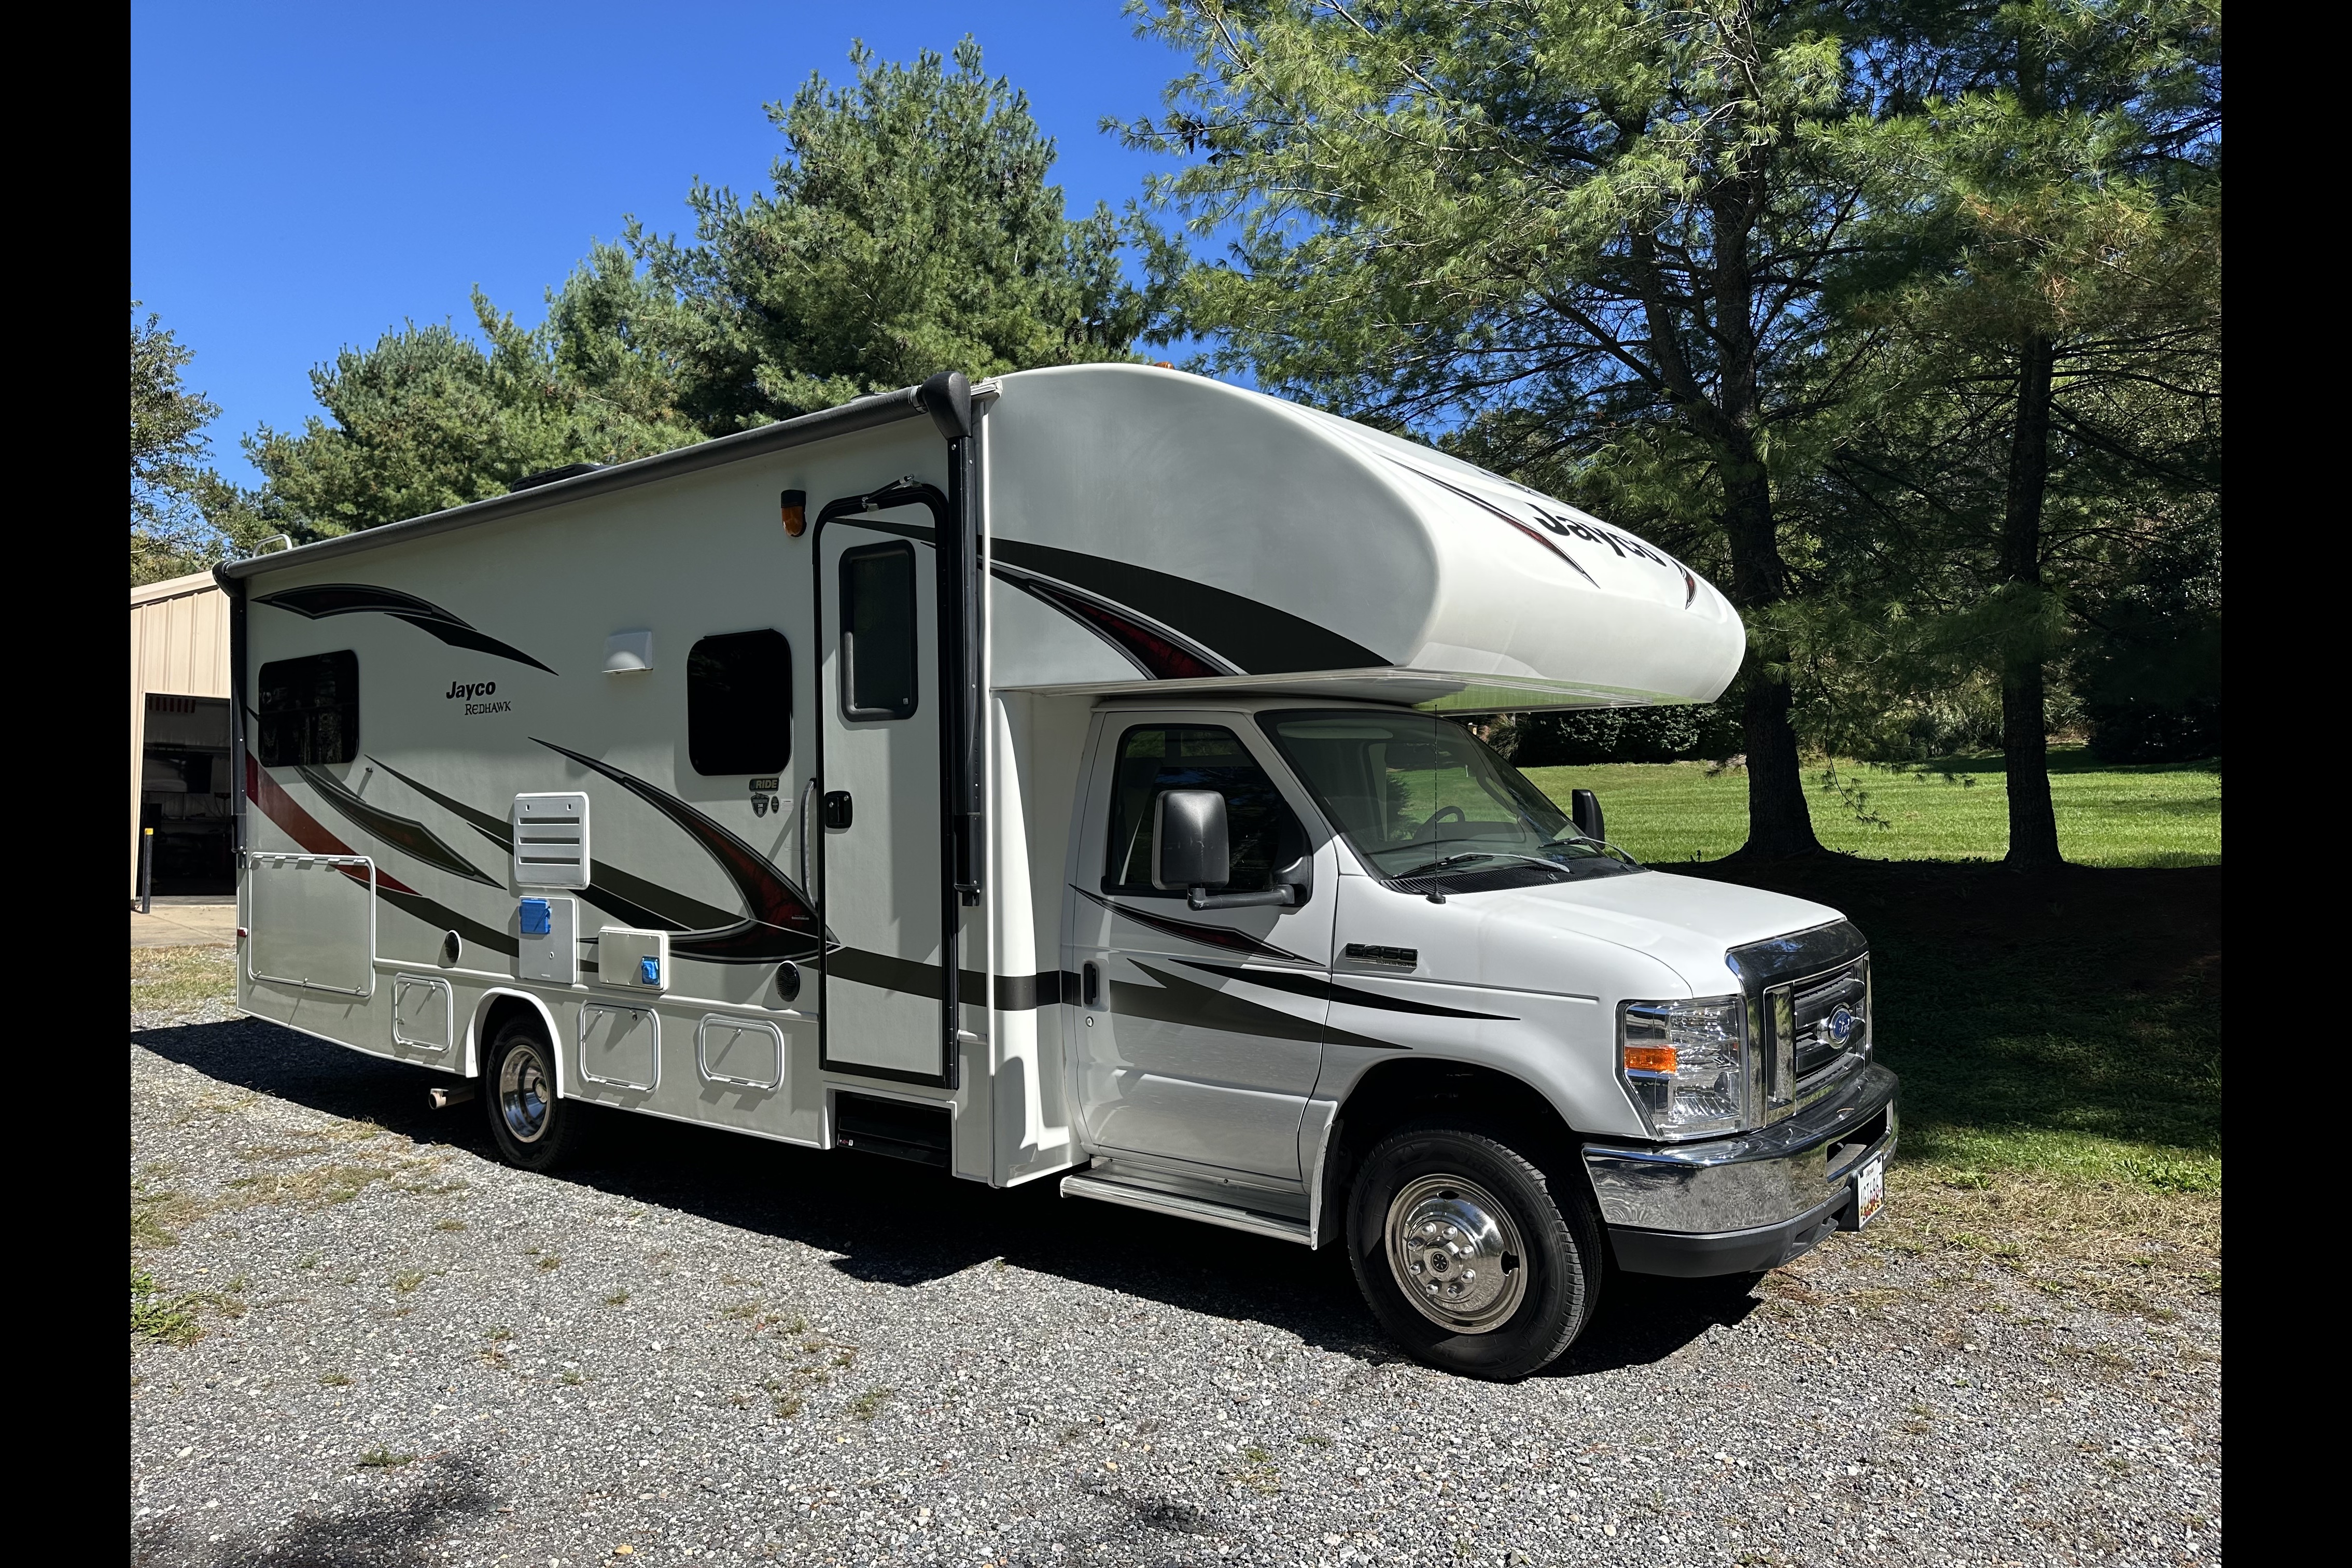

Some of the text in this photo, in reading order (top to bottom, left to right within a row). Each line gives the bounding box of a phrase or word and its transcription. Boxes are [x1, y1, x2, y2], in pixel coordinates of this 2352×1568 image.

[1524, 501, 1667, 567] Jayco
[446, 681, 496, 701] Jayco
[465, 701, 511, 715] REDHAWK
